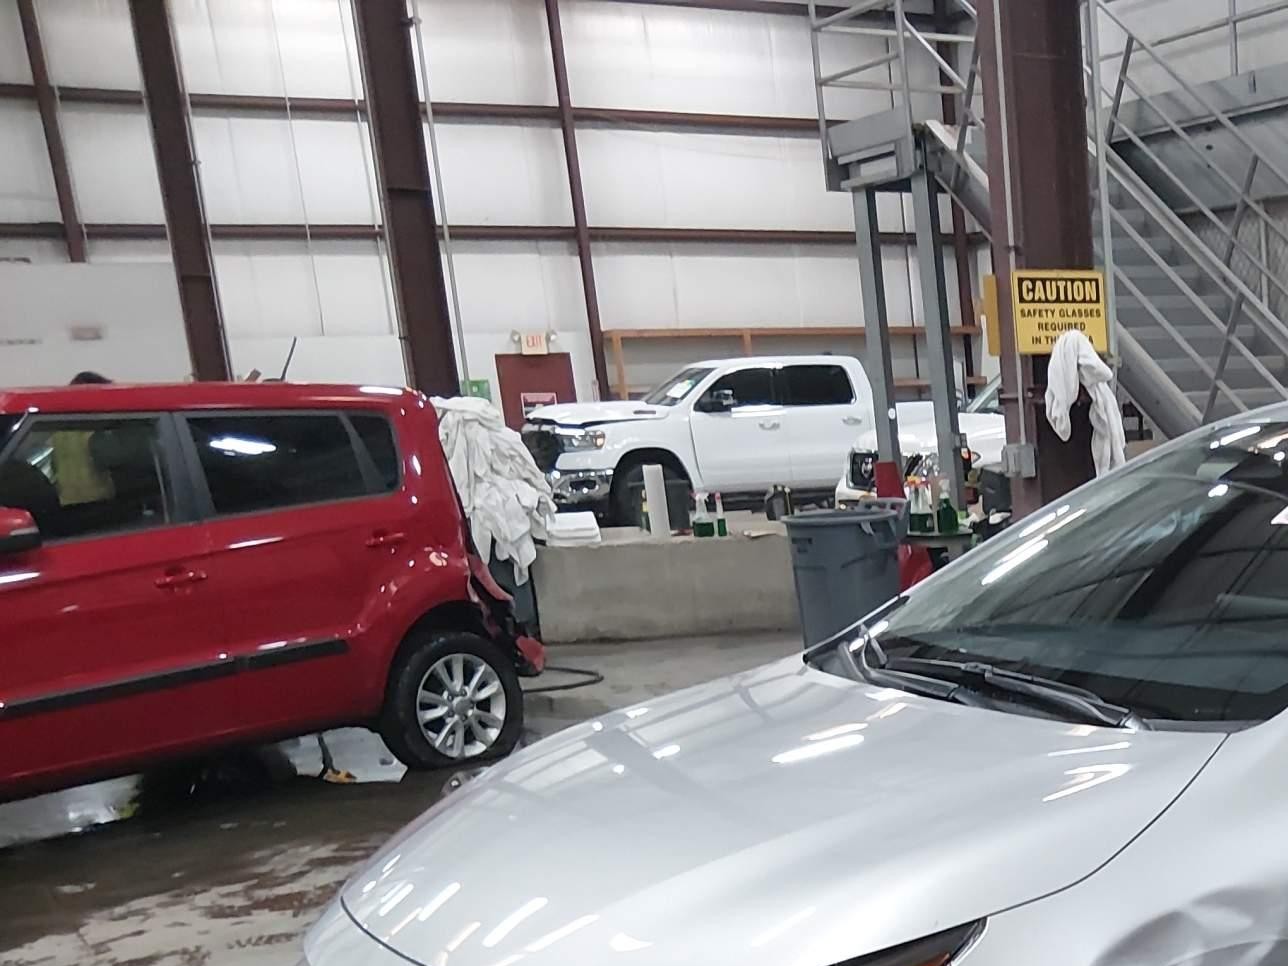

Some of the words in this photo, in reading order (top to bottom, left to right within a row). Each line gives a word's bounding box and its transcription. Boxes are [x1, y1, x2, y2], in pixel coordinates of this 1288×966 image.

[1022, 280, 1097, 301] CAUTION
[1021, 308, 1055, 318] SAFETY
[1059, 308, 1101, 318] GLASSES
[1038, 322, 1086, 331] REQUIRED
[526, 335, 543, 348] EXIT
[1032, 336, 1042, 345] IN
[1045, 336, 1060, 345] TH
